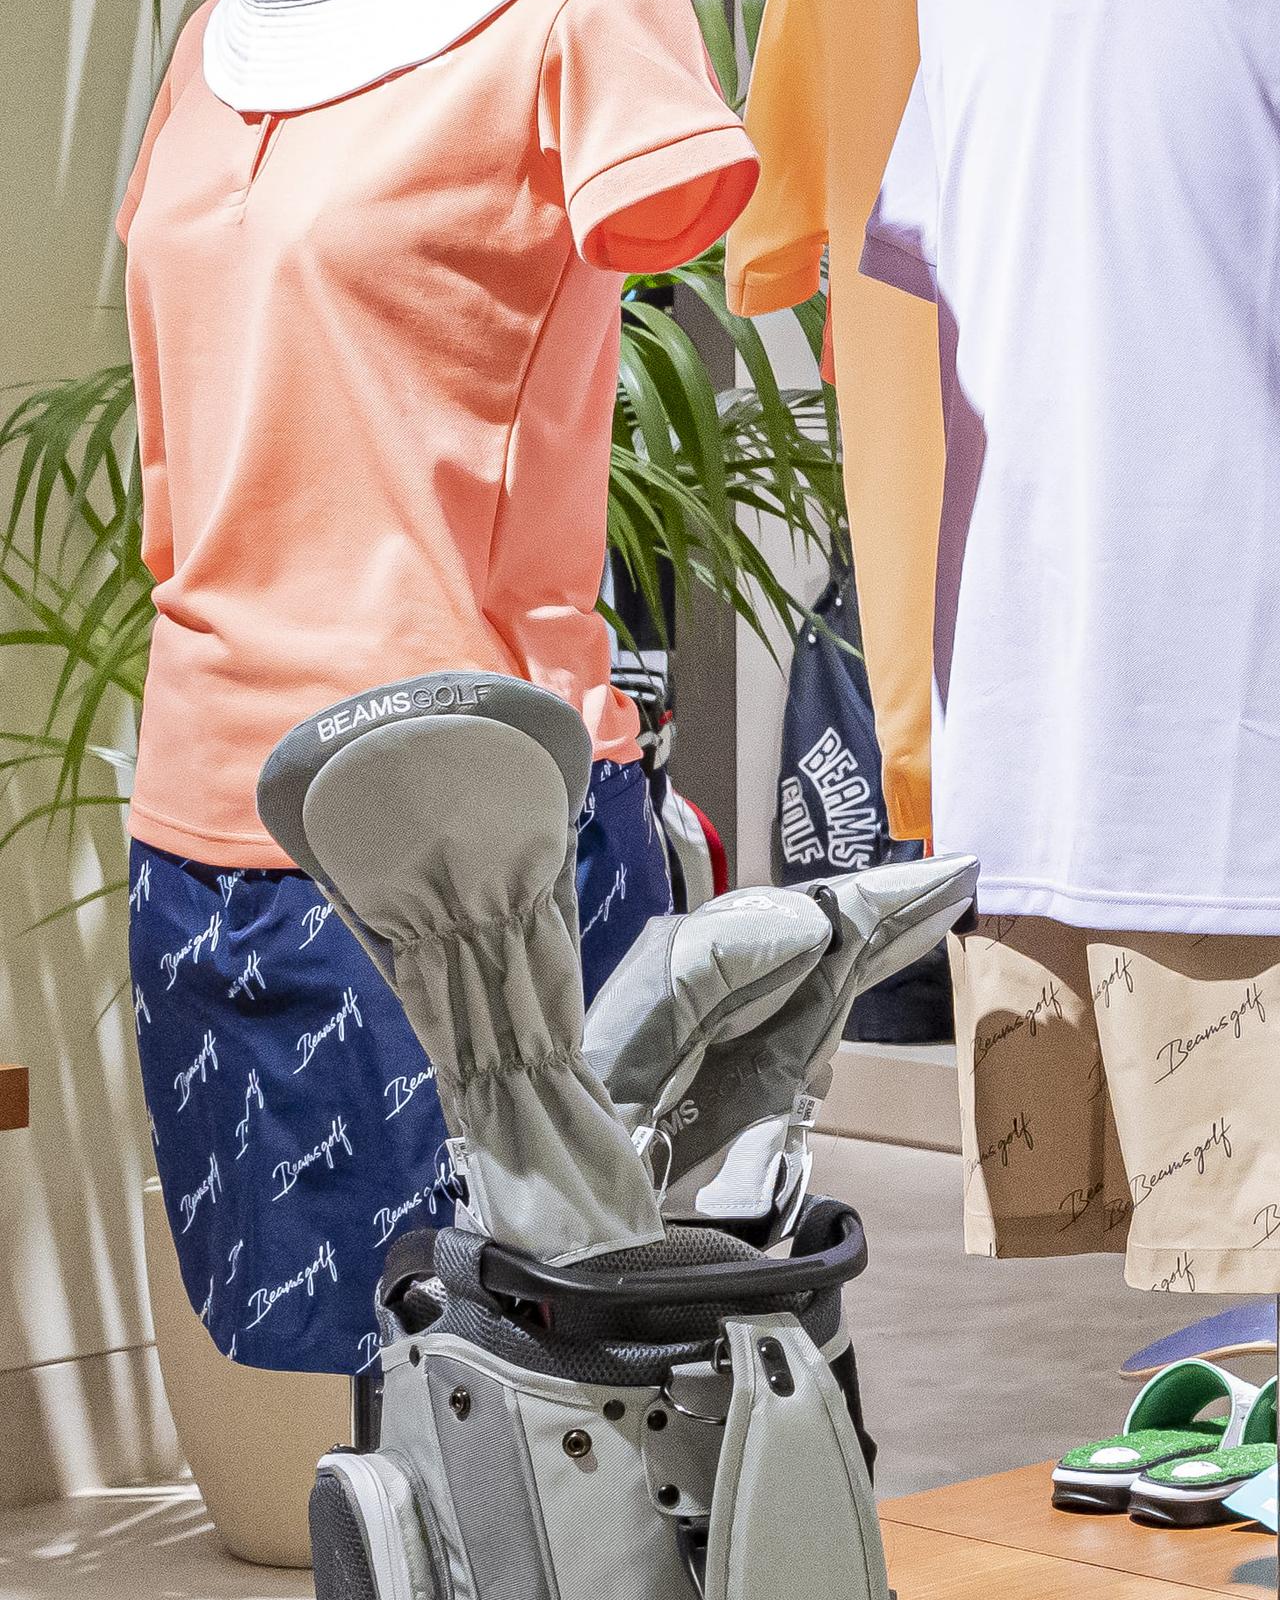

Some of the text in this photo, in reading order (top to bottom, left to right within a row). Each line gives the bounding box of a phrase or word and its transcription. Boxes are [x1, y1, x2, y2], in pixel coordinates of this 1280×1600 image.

[798, 726, 876, 871] BEAMS
[292, 986, 363, 1075] Beamsgolf
[1154, 982, 1267, 1085] Beamsgolf
[271, 1115, 353, 1202] Beamsgolf
[1131, 1116, 1233, 1208] Beamsgolf
[246, 1241, 338, 1331] Beamsgolf
